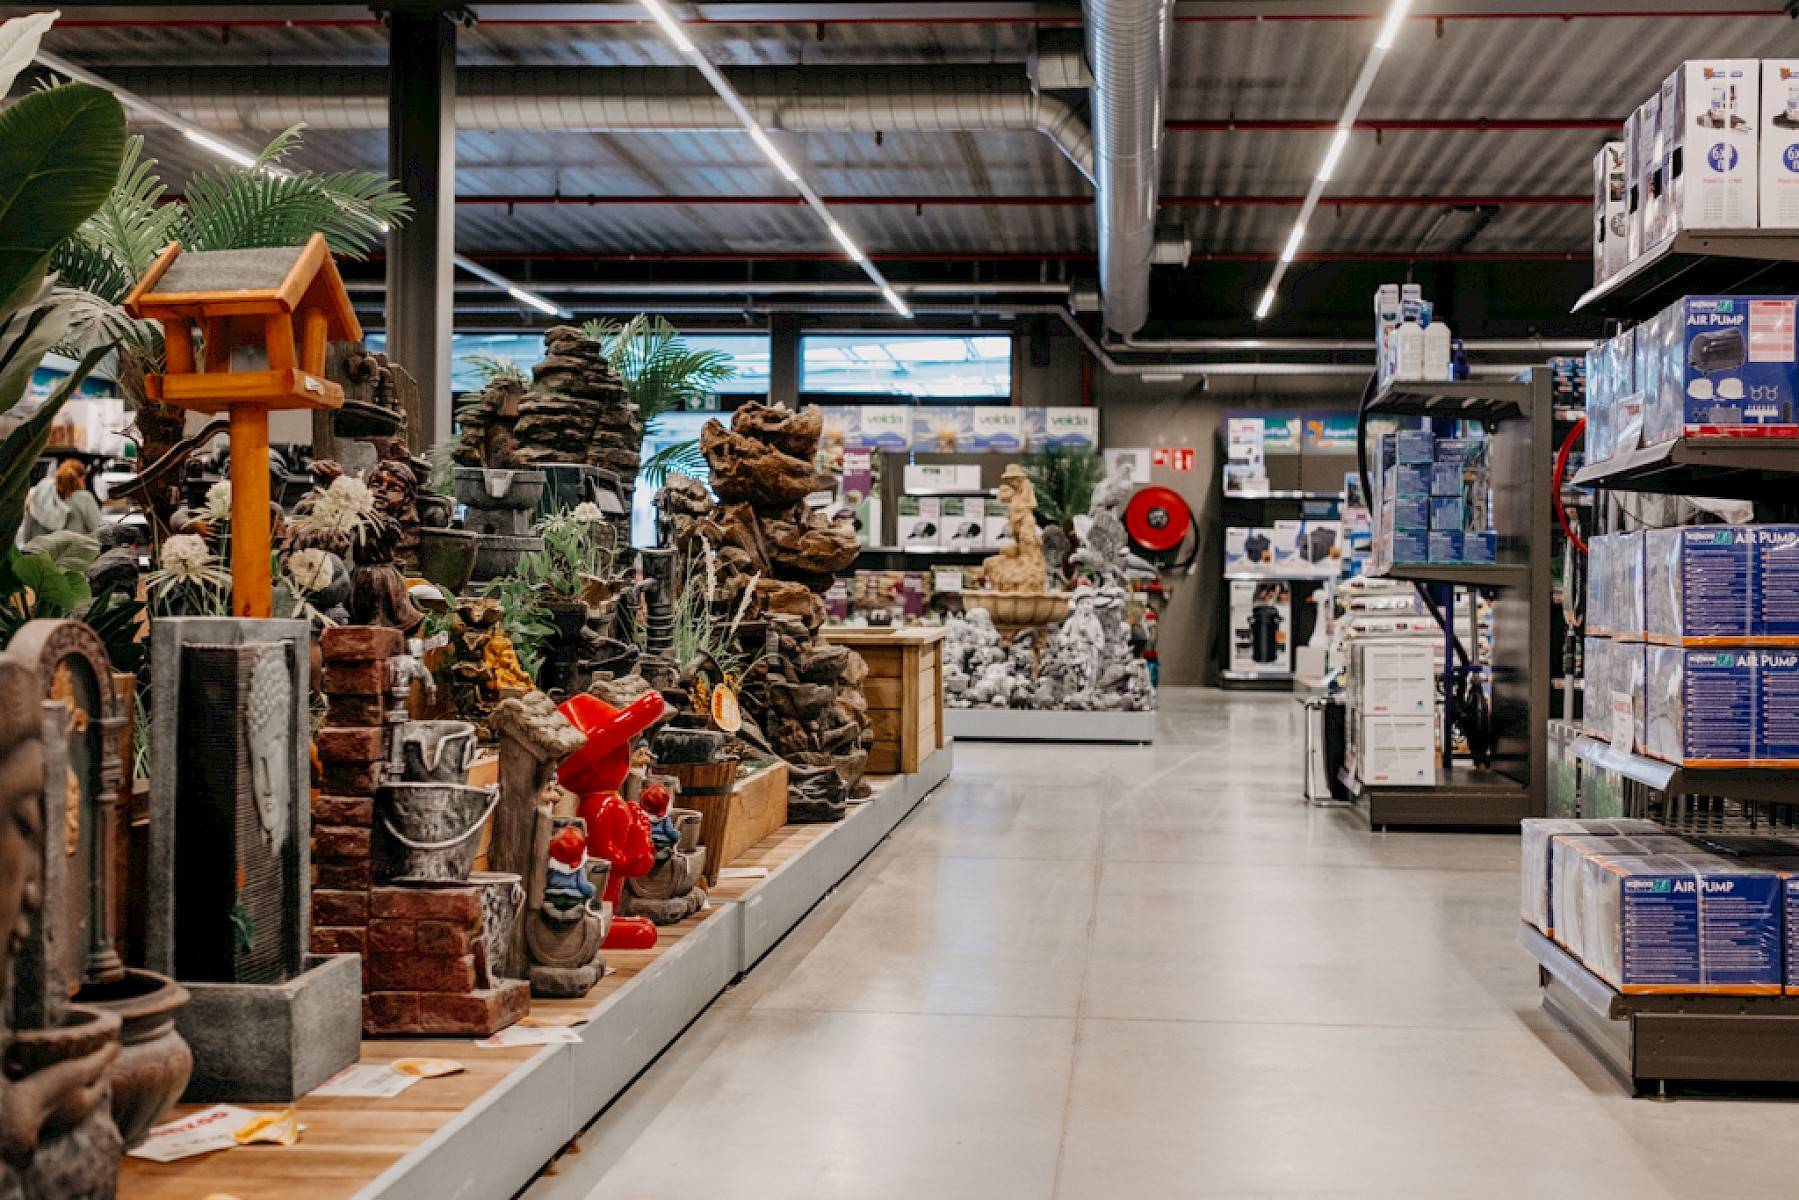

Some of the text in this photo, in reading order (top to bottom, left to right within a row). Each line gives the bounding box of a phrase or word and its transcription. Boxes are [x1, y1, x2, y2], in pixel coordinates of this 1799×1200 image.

[1687, 314, 1744, 325] AIR PUMP
[1760, 531, 1796, 544] PUMP
[1761, 655, 1798, 667] PUMP
[1673, 880, 1735, 892] AIR PUMP
